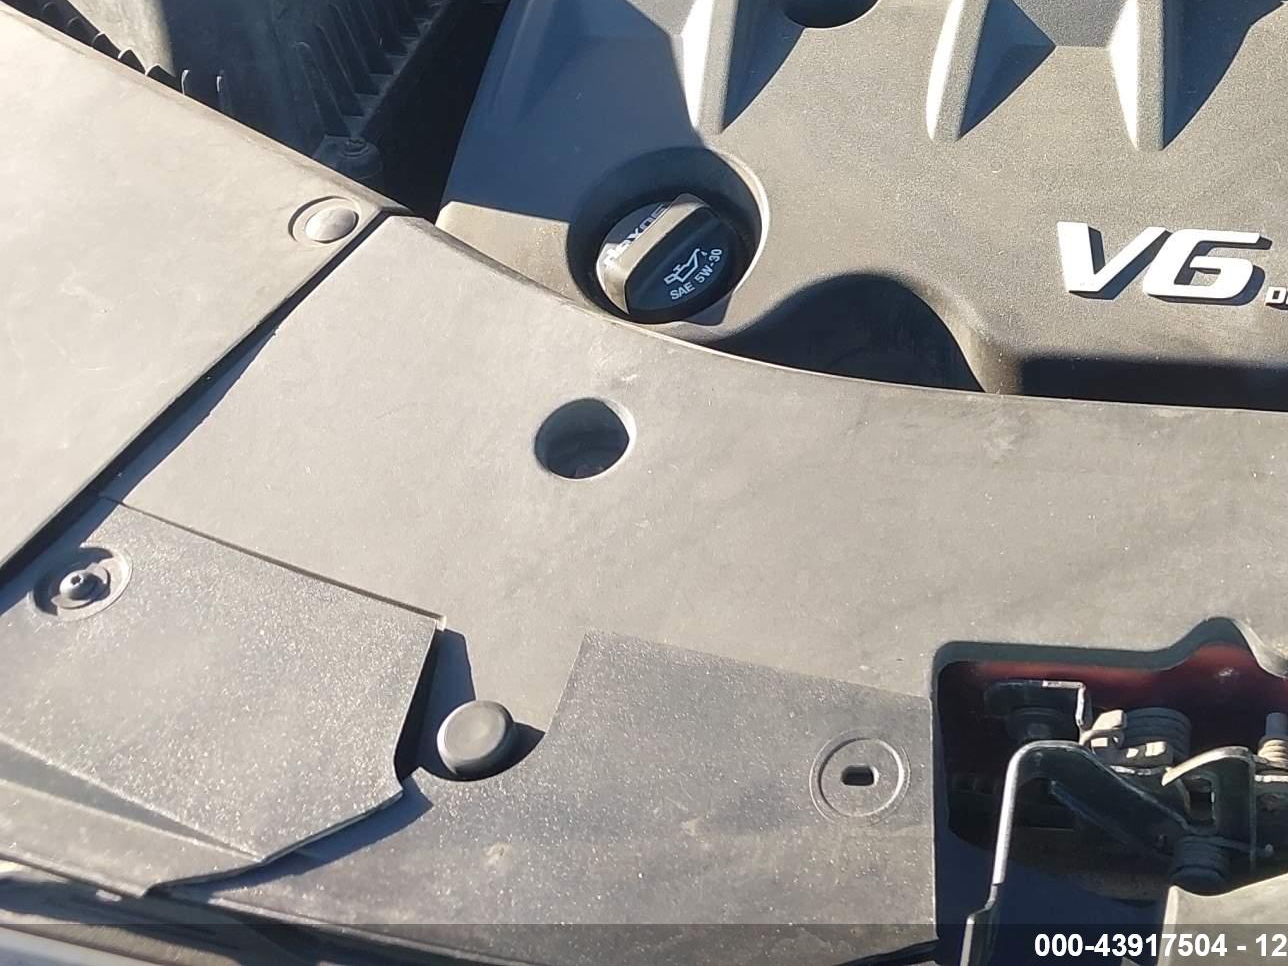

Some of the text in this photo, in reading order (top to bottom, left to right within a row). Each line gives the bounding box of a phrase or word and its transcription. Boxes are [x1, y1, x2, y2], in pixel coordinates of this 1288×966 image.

[669, 248, 723, 301] SAE 5W-30
[1057, 221, 1260, 299] V6
